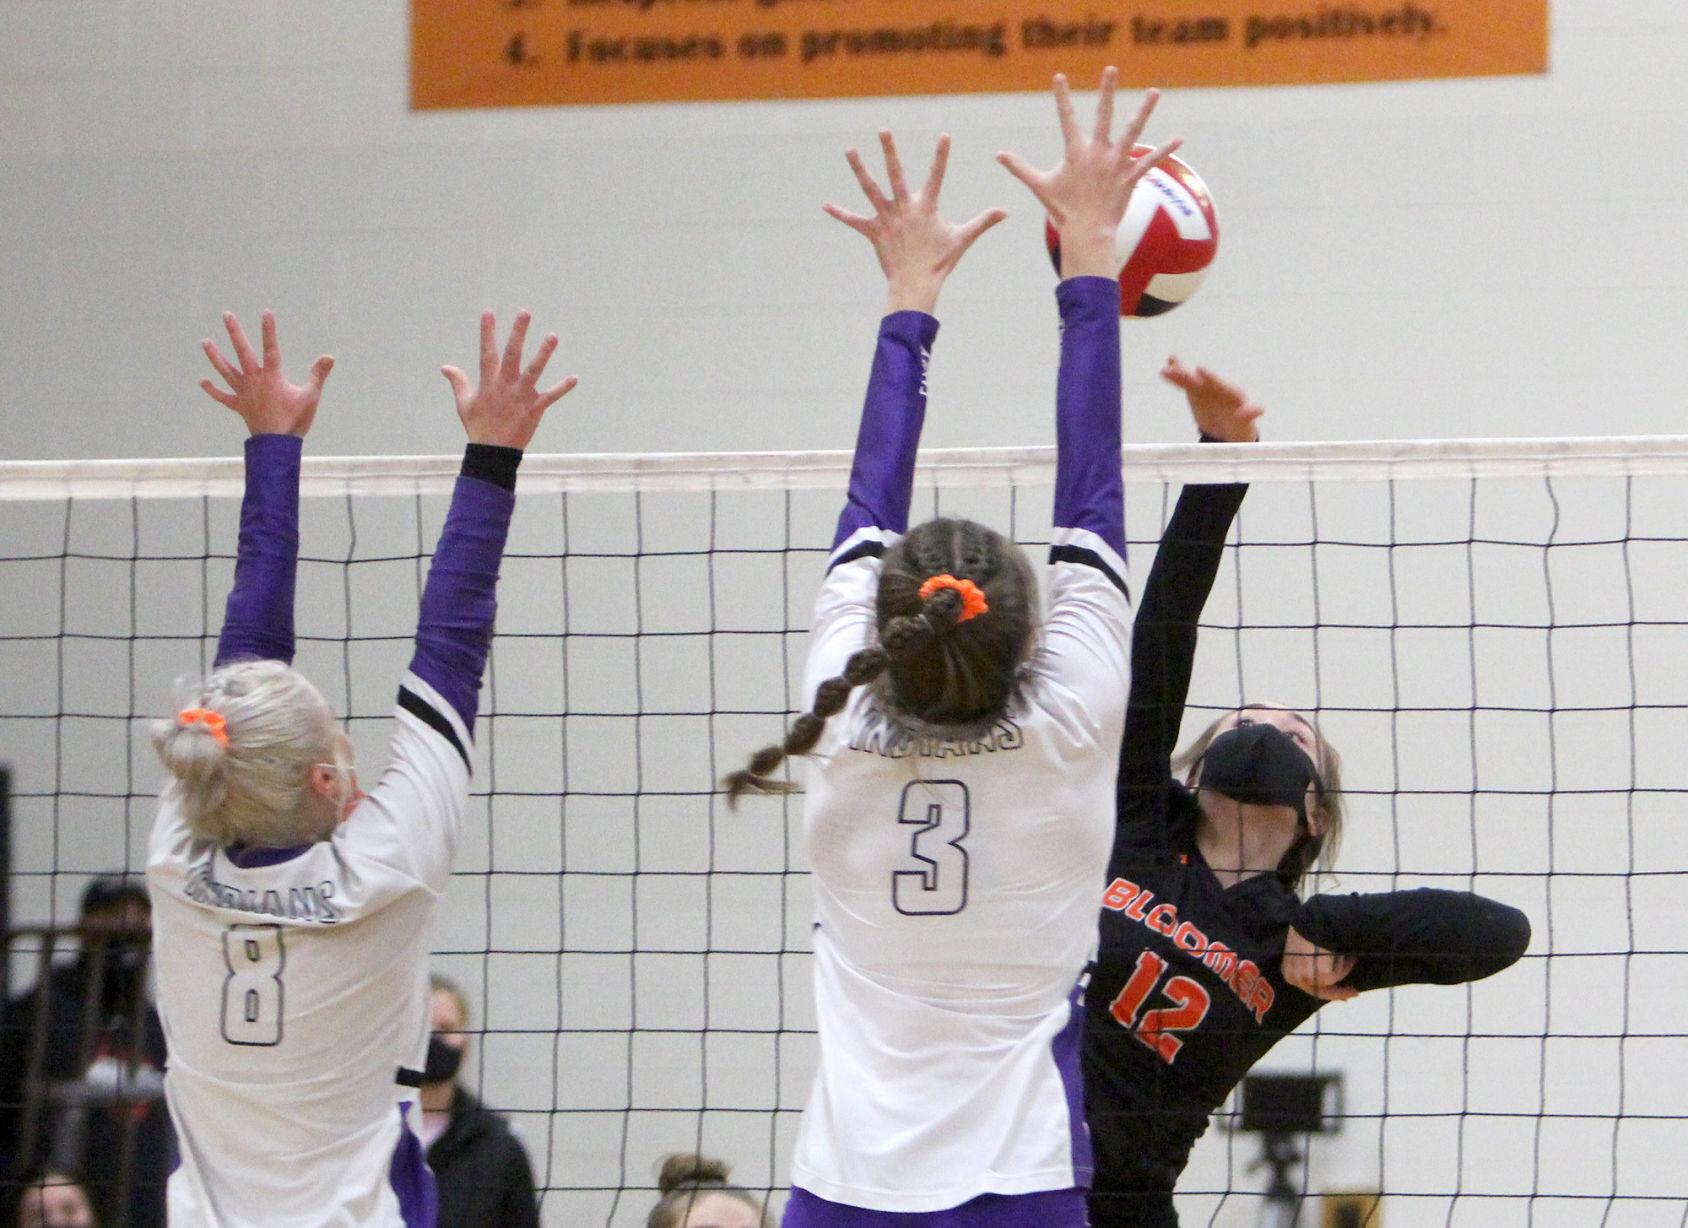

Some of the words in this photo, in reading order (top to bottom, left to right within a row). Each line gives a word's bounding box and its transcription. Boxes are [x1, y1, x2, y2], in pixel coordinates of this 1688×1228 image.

[566, 30, 725, 62] Focuses
[737, 32, 787, 58] on
[801, 20, 1007, 64] promoting
[1021, 15, 1115, 49] their
[1130, 15, 1230, 46] team
[892, 779, 970, 916] 3
[220, 923, 286, 1046] 8
[1102, 877, 1275, 1025] BLOOMER
[1109, 948, 1211, 1065] 12
